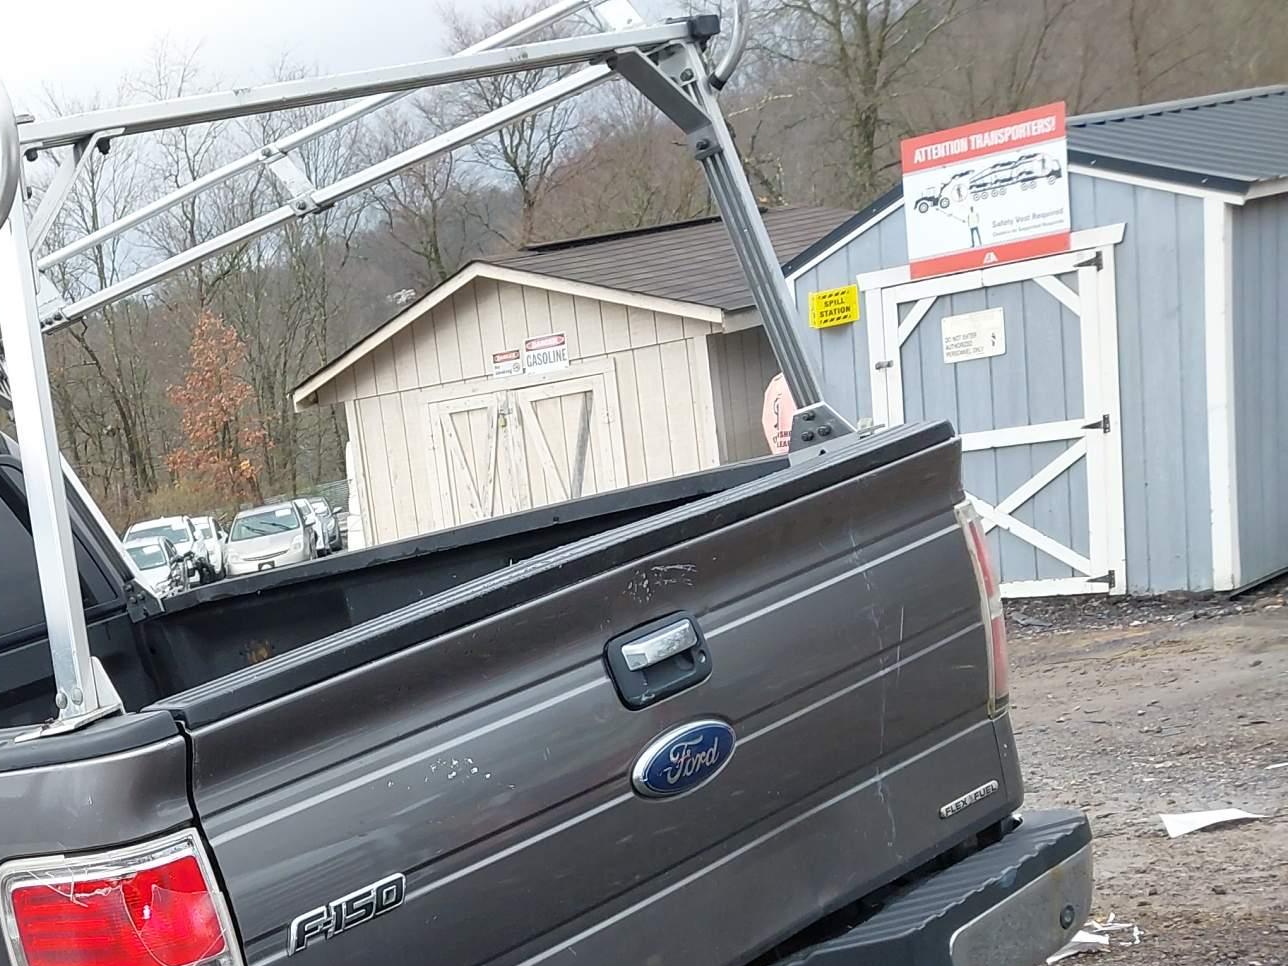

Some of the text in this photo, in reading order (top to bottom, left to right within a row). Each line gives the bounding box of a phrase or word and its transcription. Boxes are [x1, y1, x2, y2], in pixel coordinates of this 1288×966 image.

[914, 116, 1057, 164] ATTENTION TRANSPORTERS!
[820, 306, 851, 318] STATION
[824, 298, 845, 308] SPILL
[526, 349, 567, 367] GASOLINE
[663, 735, 720, 785] Ford
[945, 784, 997, 817] FLEX FUEL
[288, 872, 406, 957] F-150
